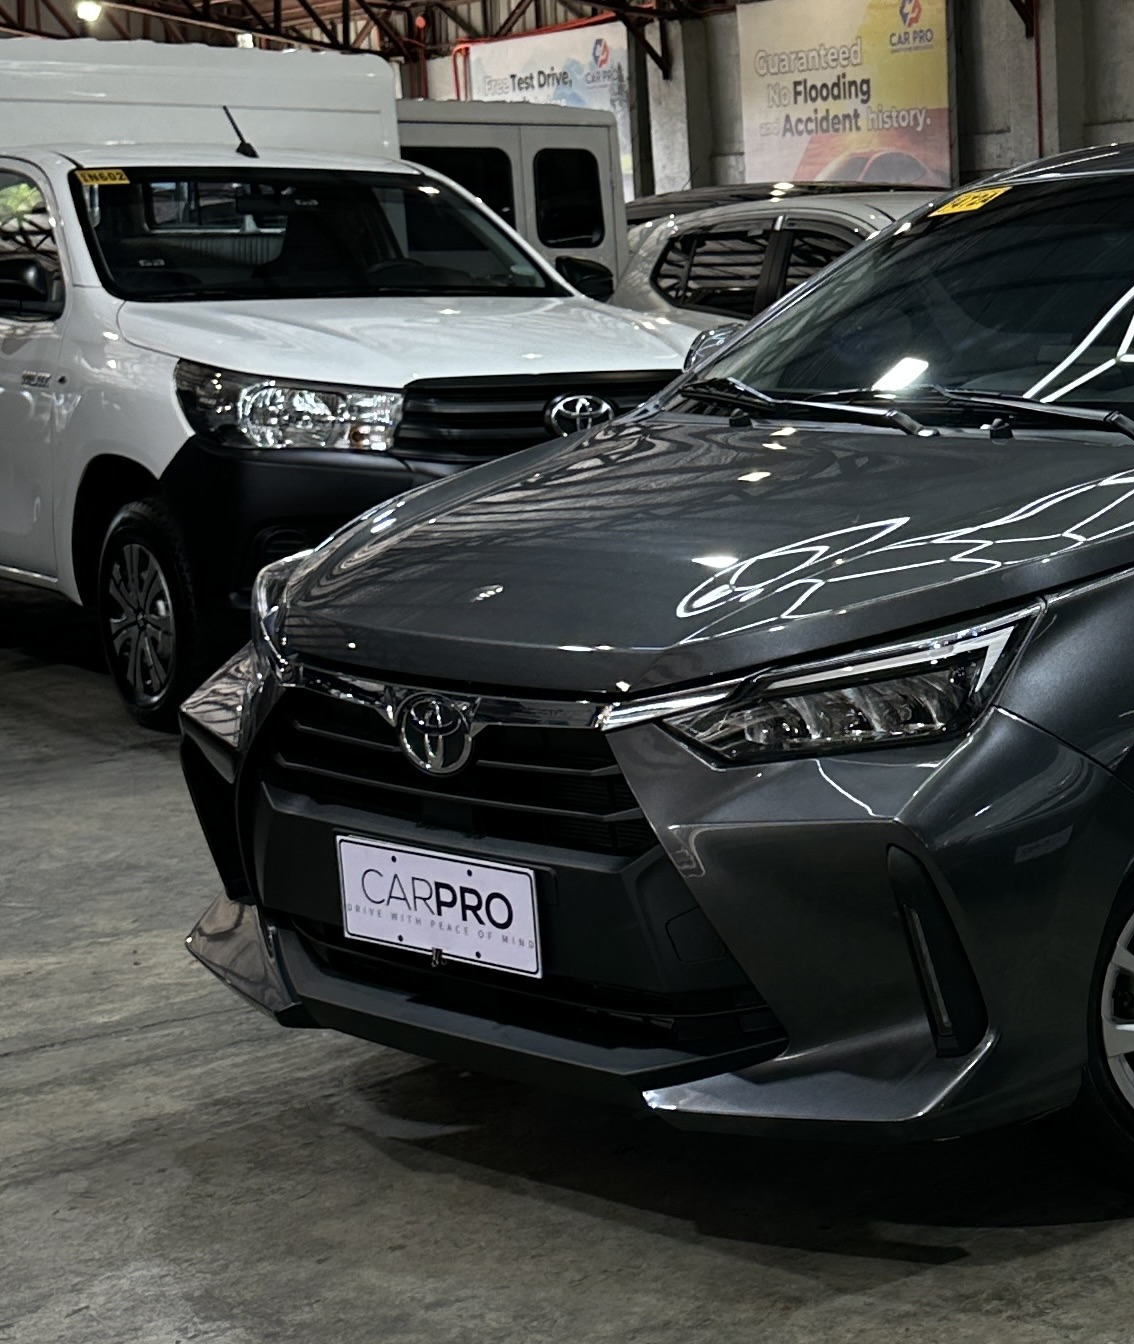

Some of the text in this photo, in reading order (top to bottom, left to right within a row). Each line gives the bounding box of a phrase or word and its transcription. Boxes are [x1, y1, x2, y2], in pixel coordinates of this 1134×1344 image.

[890, 28, 933, 46] CAR PRO
[755, 36, 862, 77] Guaranteed
[510, 72, 535, 92] Test
[537, 66, 573, 89] Drive,
[767, 72, 871, 108] No Flooding
[782, 108, 861, 137] Accident
[866, 104, 931, 132] history.
[361, 868, 513, 930] CARPRO
[347, 903, 535, 949] DRIVE WITH PEACE OF MIND
